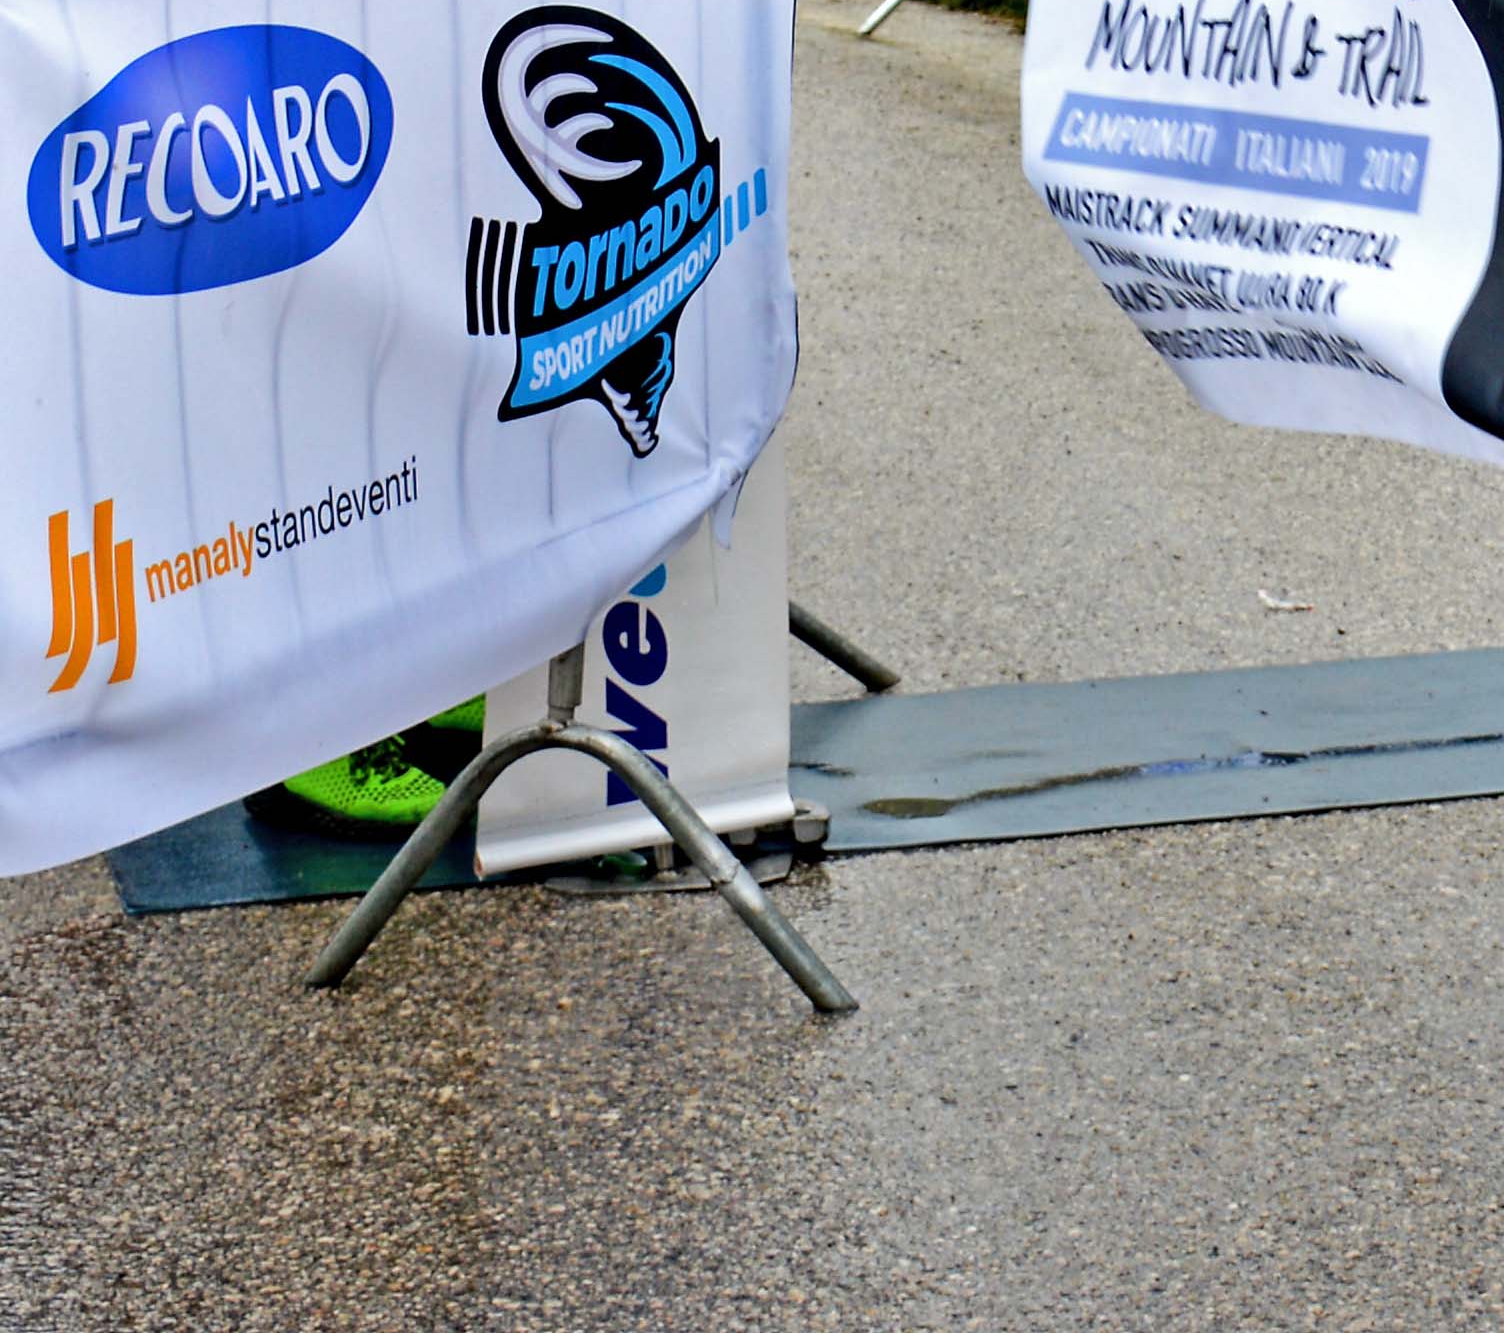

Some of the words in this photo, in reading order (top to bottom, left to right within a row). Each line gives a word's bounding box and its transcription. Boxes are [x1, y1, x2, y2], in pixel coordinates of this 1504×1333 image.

[1291, 14, 1327, 80] &
[1335, 5, 1430, 109] TRAIL
[59, 72, 372, 251] RECOARO
[1043, 183, 1172, 234] MAISTRACK
[1060, 107, 1217, 166] CAMPIONATI
[1234, 128, 1346, 185] ITALIANI
[1359, 145, 1419, 196] 2019
[529, 325, 600, 391] SPORT
[598, 230, 712, 355] NUTRITION
[144, 455, 419, 604] manalystandeventi
